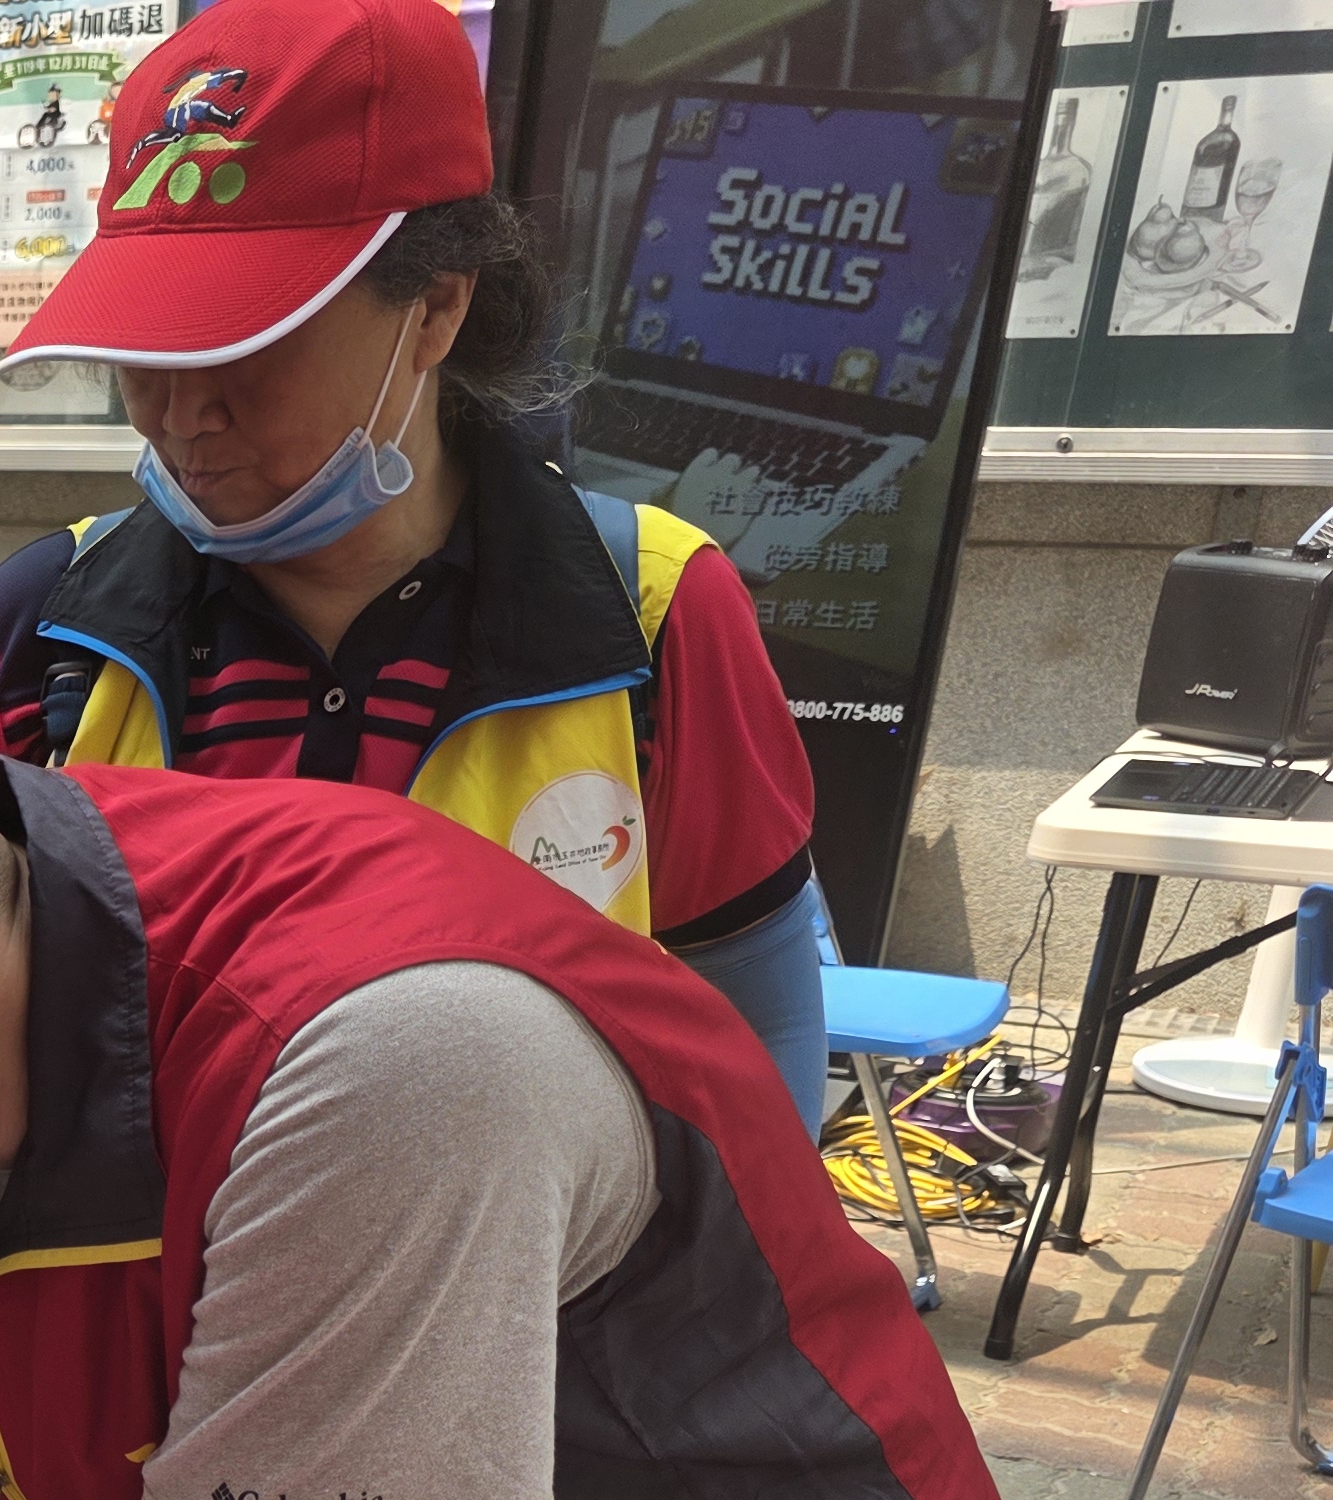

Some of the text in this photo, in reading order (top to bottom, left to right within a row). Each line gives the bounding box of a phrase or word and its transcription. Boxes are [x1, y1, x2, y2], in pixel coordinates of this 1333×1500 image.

[78, 4, 163, 40] 加碼退
[756, 599, 879, 629] 日常生活
